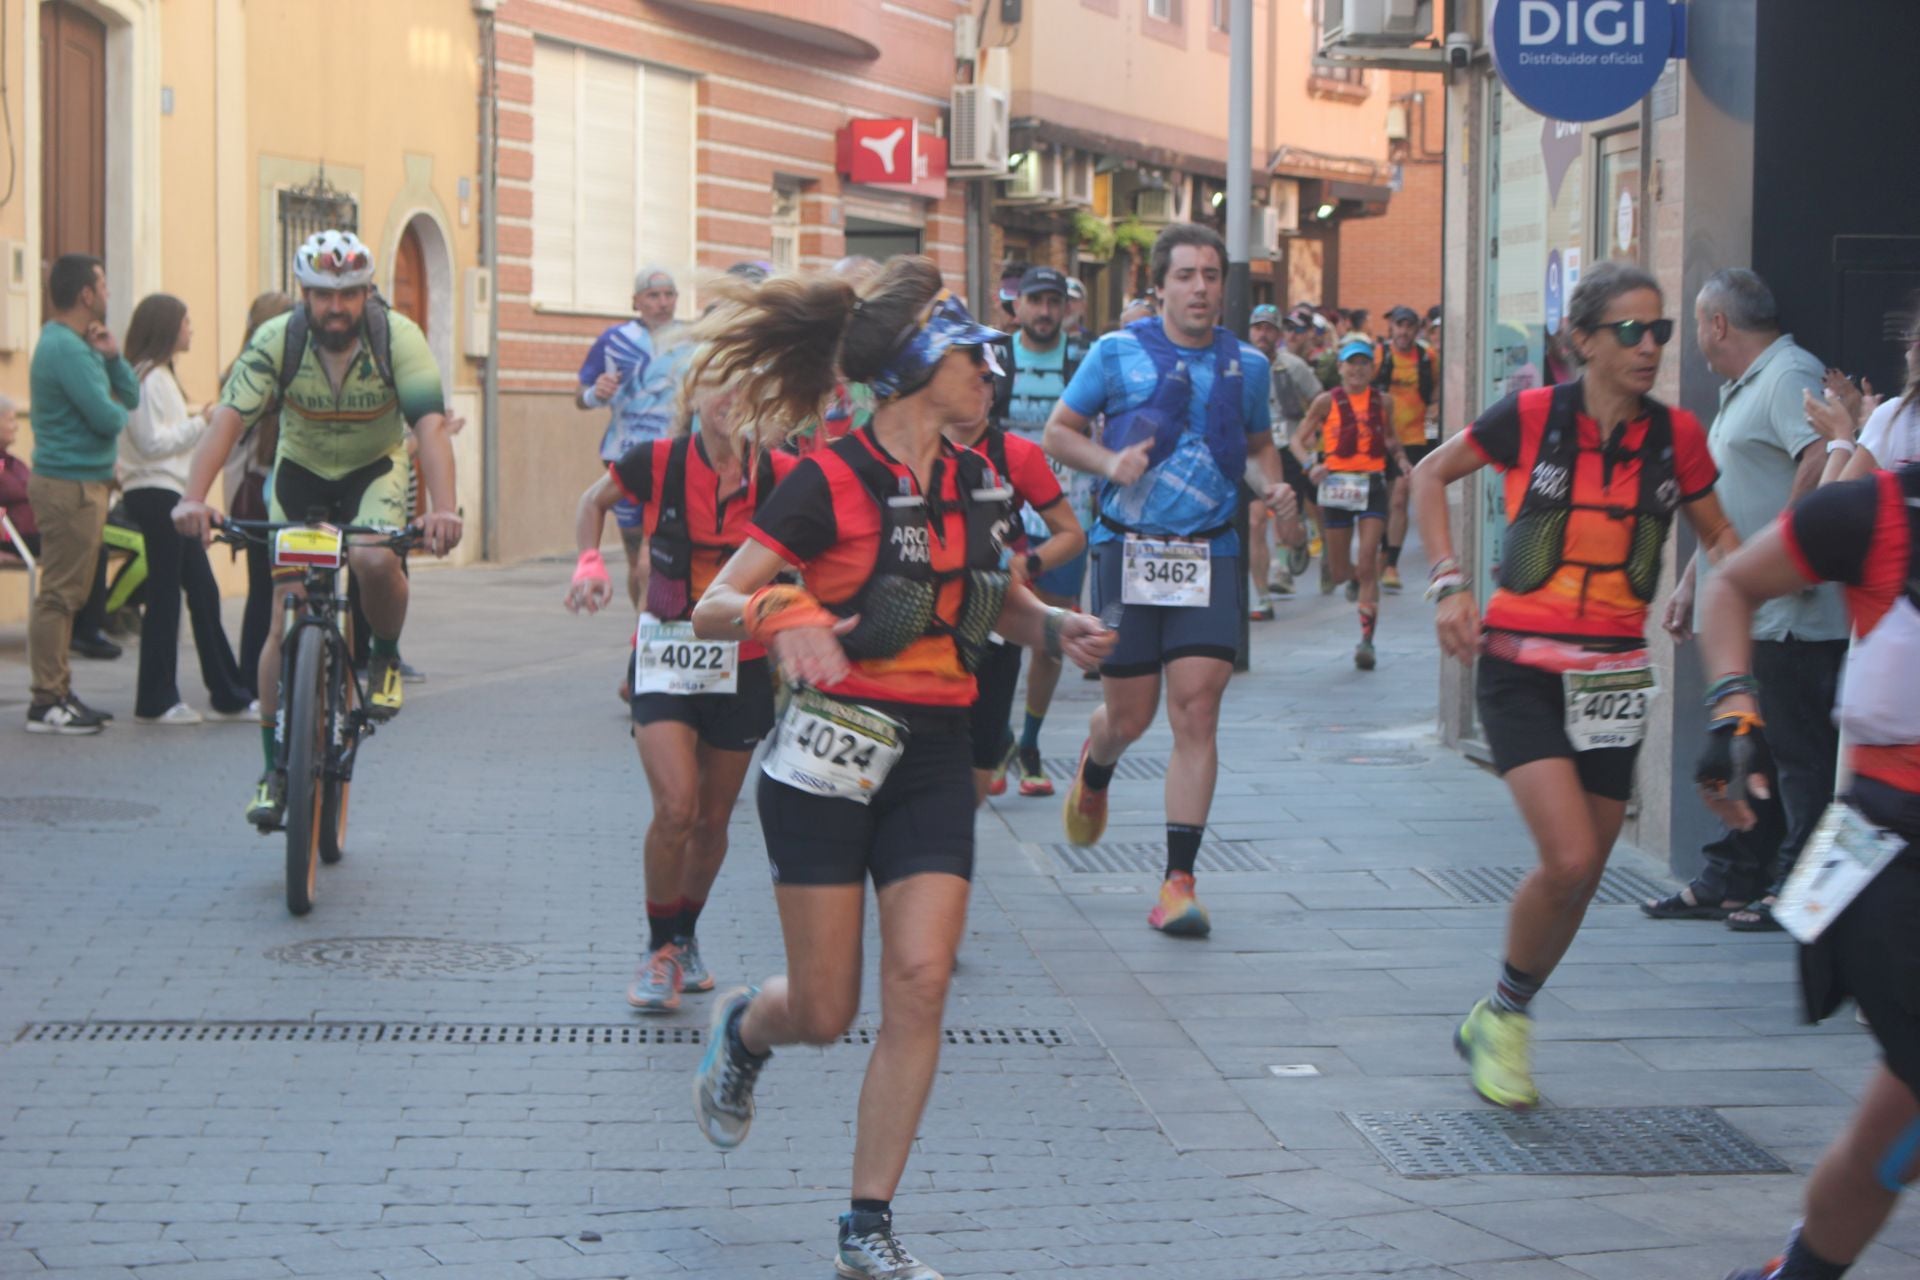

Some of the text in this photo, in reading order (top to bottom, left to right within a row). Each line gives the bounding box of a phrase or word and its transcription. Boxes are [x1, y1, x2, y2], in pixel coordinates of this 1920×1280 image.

[1519, 0, 1645, 46] DIGI
[1519, 52, 1643, 65] Distribuidor oficial
[1144, 561, 1198, 583] 3462
[660, 644, 724, 670] 4022
[1583, 692, 1647, 721] 4023
[797, 719, 877, 773] 4024
